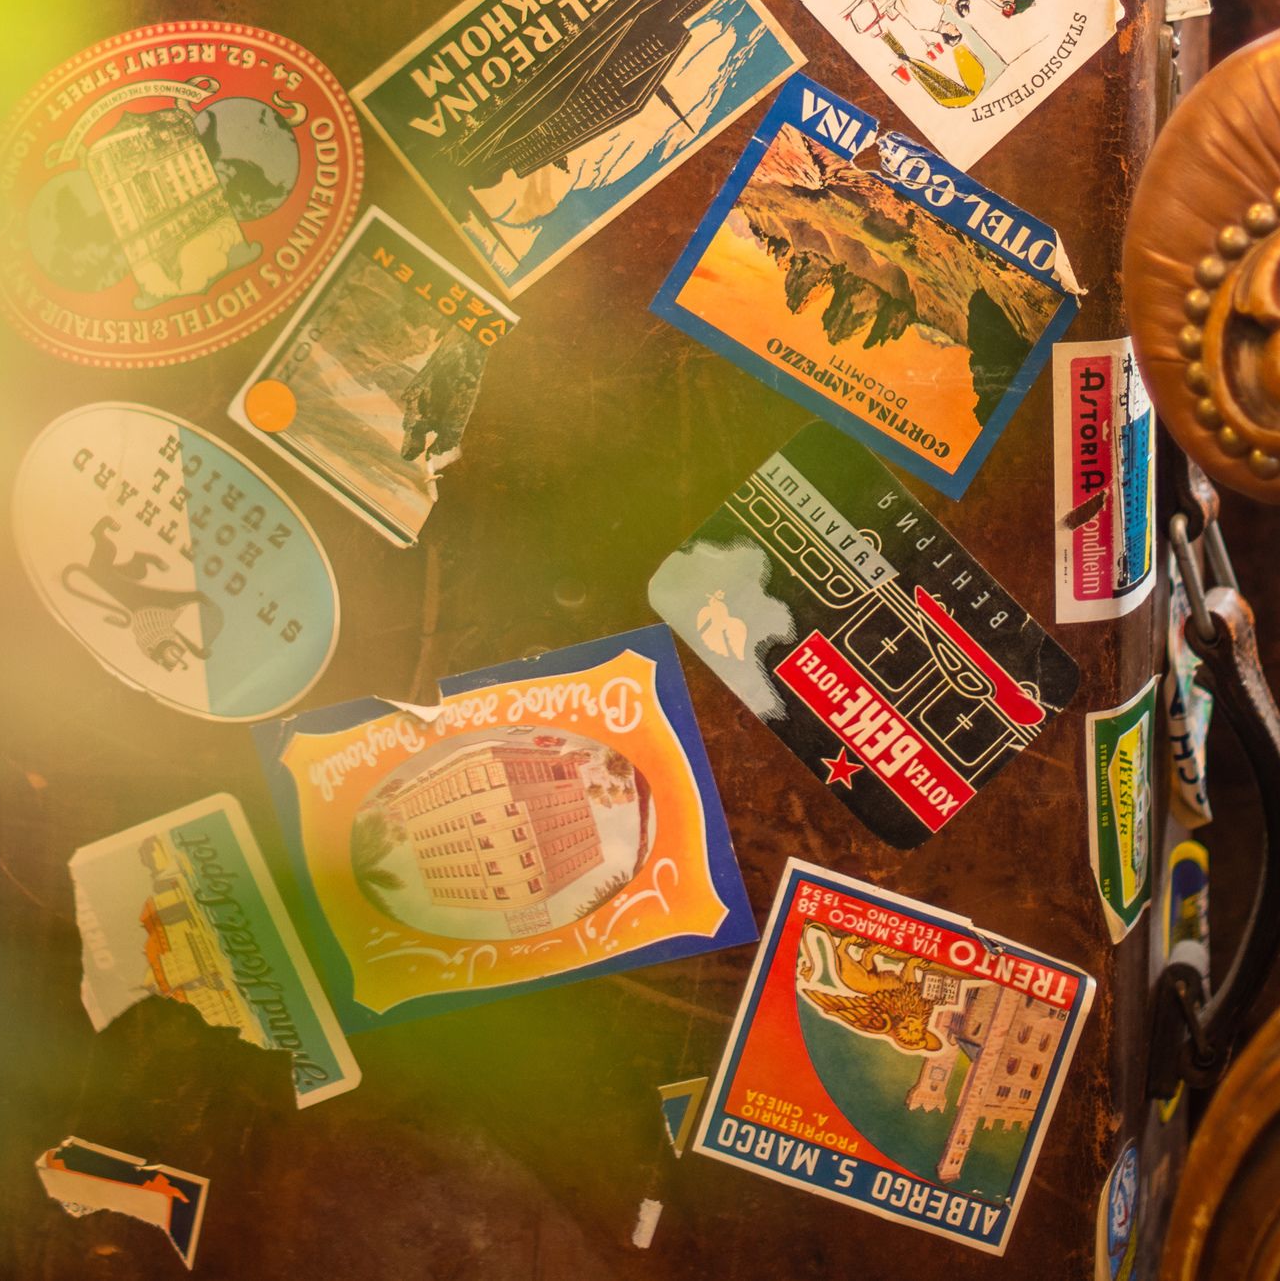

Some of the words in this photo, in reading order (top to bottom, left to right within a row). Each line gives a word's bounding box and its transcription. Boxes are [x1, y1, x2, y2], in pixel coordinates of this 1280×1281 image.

[124, 43, 217, 76] REGENT
[409, 14, 564, 138] REGINA
[971, 12, 1087, 122] STADSHOTELLET
[46, 61, 123, 122] STREET
[260, 116, 341, 291] ODDENINO'S
[963, 194, 1061, 281] OTEL
[174, 278, 263, 339] HOTEL
[828, 354, 908, 410] DOLOMITI
[867, 397, 950, 458] CORTINA
[72, 448, 247, 596] GOTTHARD
[151, 467, 264, 569] HOTEL
[767, 466, 885, 581] БУДАПЕШТ
[877, 490, 1009, 629] ВЕНГРИЯ
[1082, 514, 1106, 595] ondheim
[507, 676, 643, 734] Bristol
[795, 647, 850, 704] HOTEL
[435, 692, 499, 736] Hotel
[828, 685, 923, 779] БЕКЕ
[308, 716, 426, 802] Beyrouth
[903, 758, 959, 817] ХОТЕЛ
[797, 897, 819, 917] 38
[801, 884, 840, 906] 1354
[867, 908, 942, 942] TELEFONO
[913, 938, 939, 958] VIA
[949, 940, 1069, 1005] TRENTO
[741, 1103, 859, 1153] PROPRIETARIO
[746, 1089, 804, 1117] CHIESA
[812, 1110, 829, 1127] A.
[716, 1116, 821, 1176] MARCO
[831, 1154, 858, 1188] S.
[871, 1171, 1002, 1236] ALBERGO
